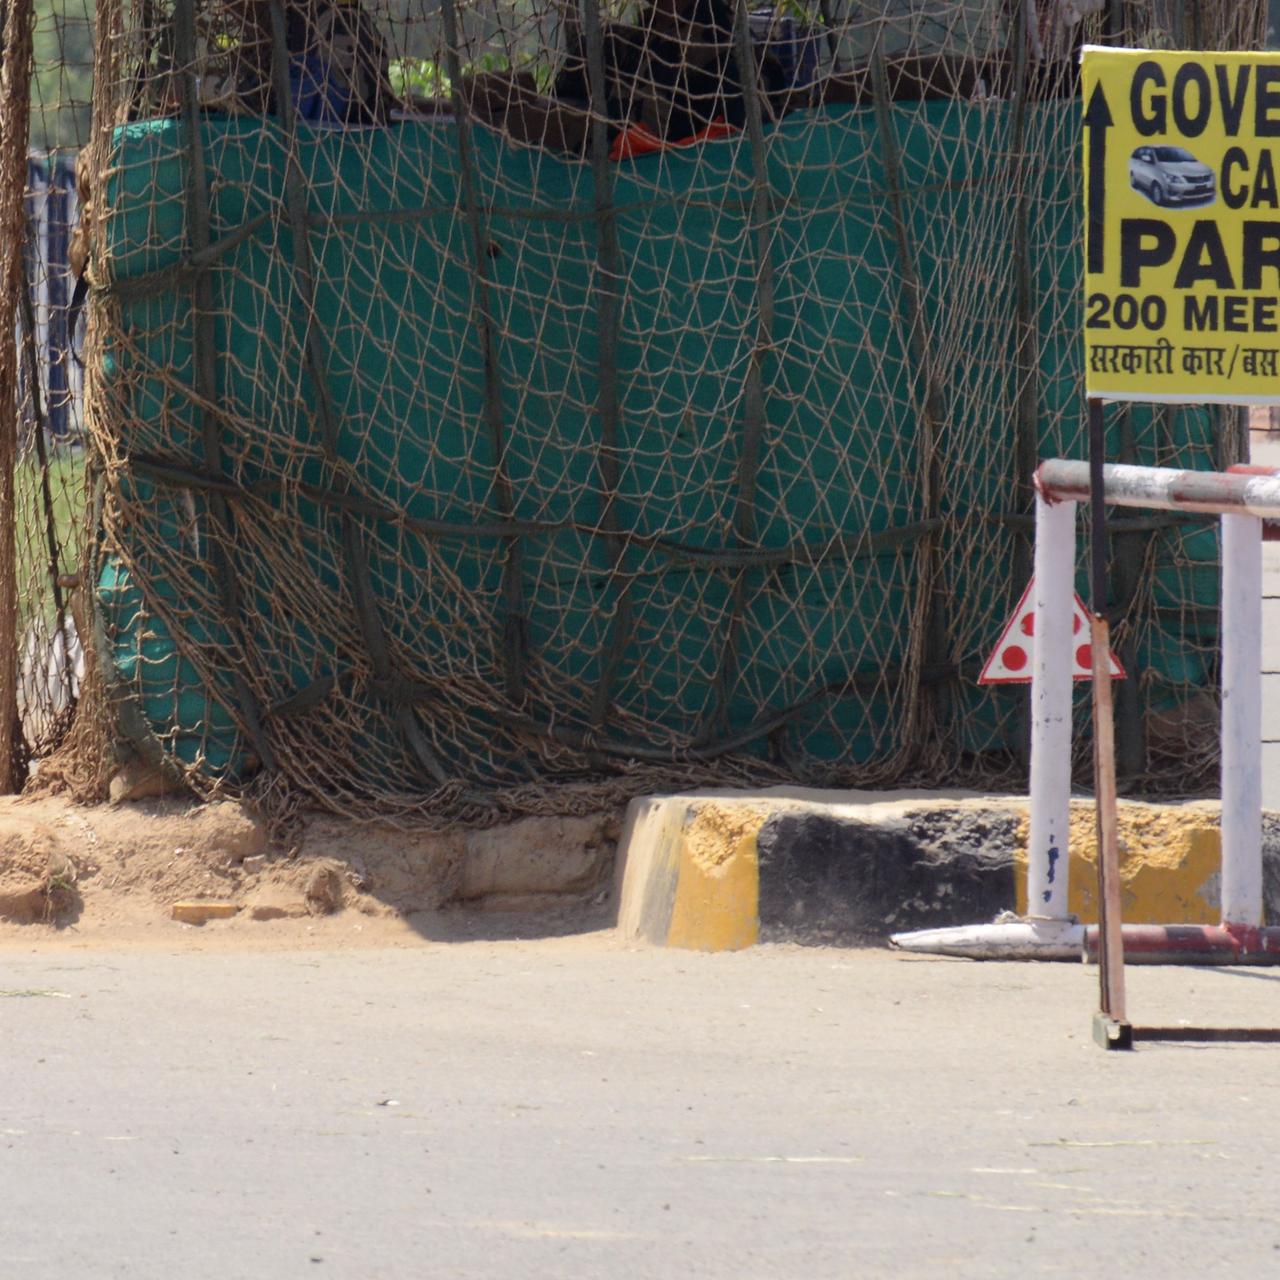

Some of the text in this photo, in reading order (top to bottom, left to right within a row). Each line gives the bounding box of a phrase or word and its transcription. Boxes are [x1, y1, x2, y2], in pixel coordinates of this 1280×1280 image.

[1130, 61, 1280, 138] GOVE
[1221, 146, 1279, 209] CA
[1121, 218, 1280, 290] PAR
[1086, 294, 1278, 333] 200 MEE
[1090, 338, 1177, 375] सरकारी
